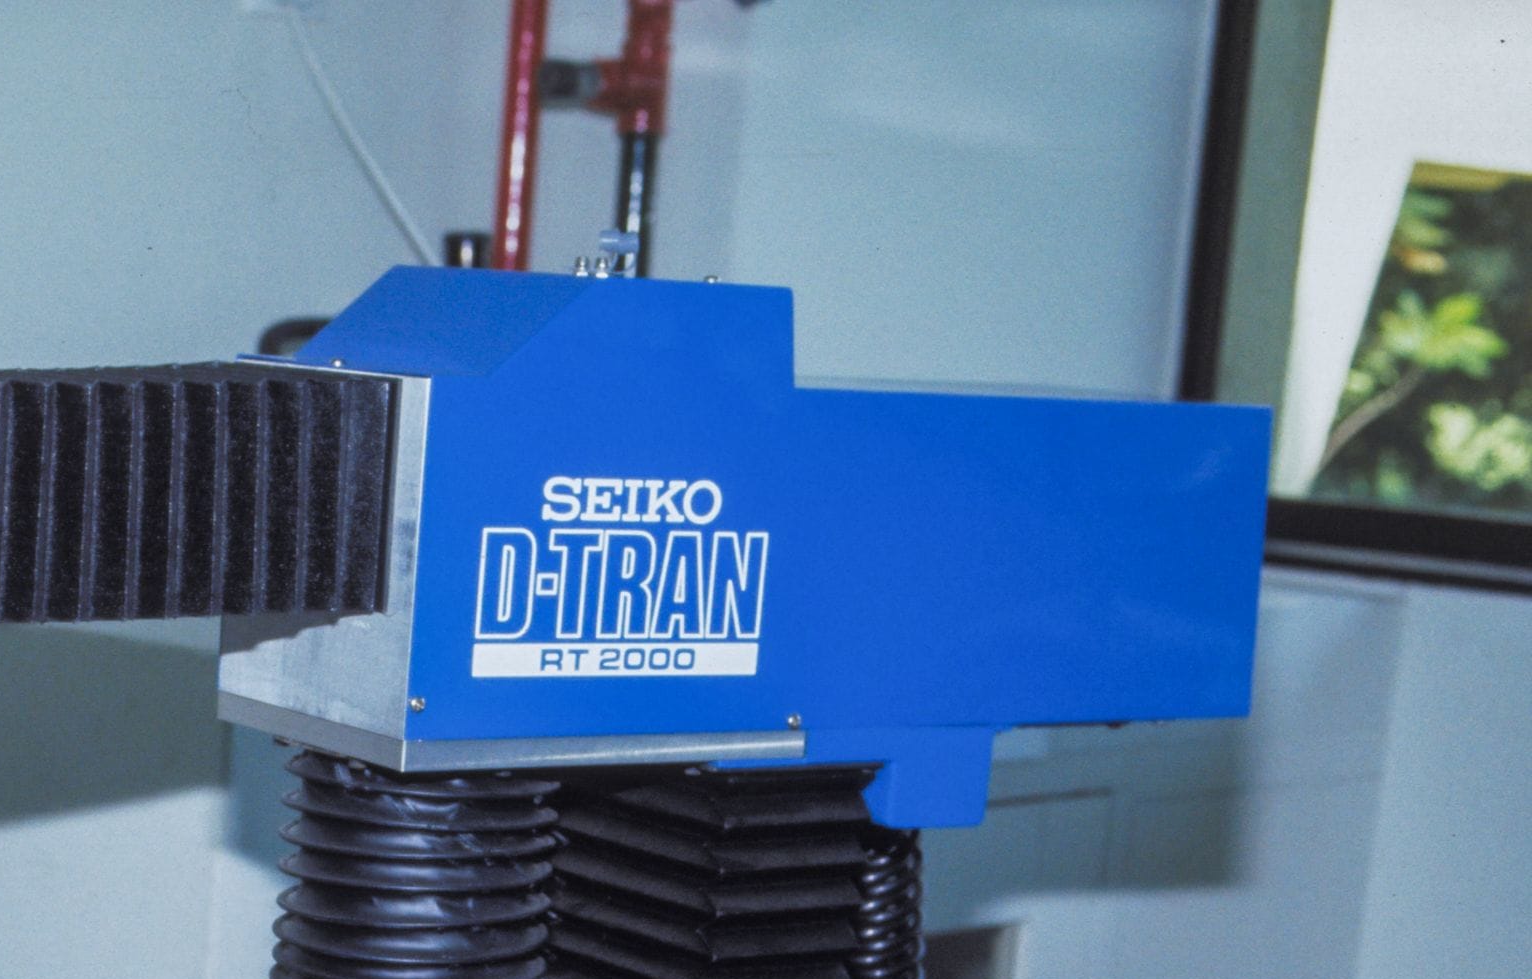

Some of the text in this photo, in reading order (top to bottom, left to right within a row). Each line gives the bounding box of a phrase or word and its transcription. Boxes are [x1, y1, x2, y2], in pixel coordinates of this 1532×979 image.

[541, 476, 722, 525] SEIKO
[475, 527, 769, 639] D-TRAN
[540, 648, 696, 671] RT 2000
